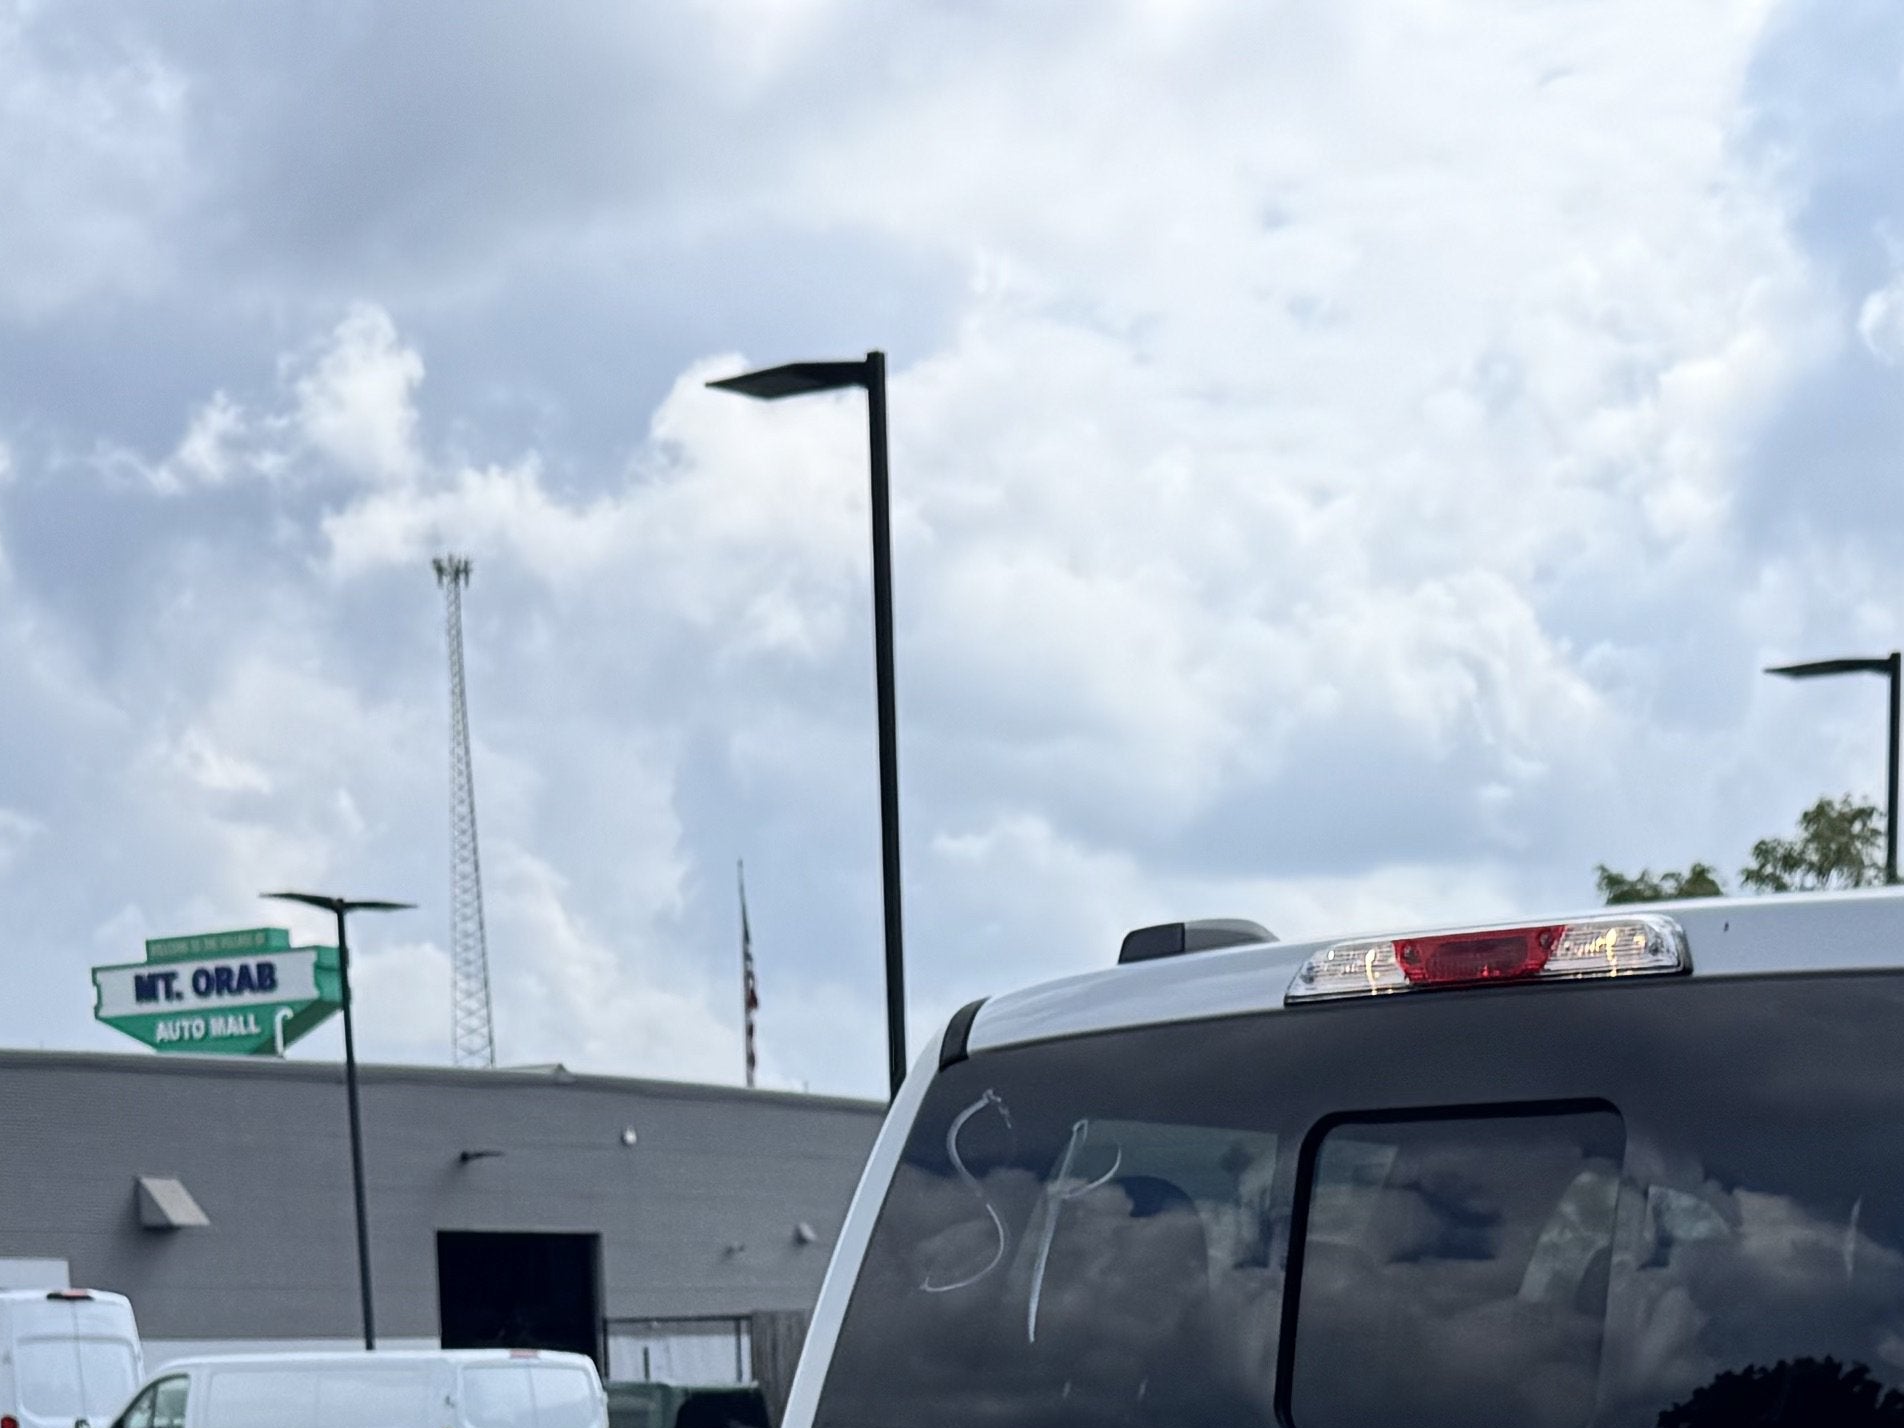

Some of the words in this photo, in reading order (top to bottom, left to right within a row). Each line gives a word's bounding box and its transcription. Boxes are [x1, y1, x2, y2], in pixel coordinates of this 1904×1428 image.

[134, 971, 183, 1003] MT.
[192, 962, 278, 997] ORAB
[156, 1018, 206, 1042] AUTO
[210, 1014, 261, 1037] MALL
